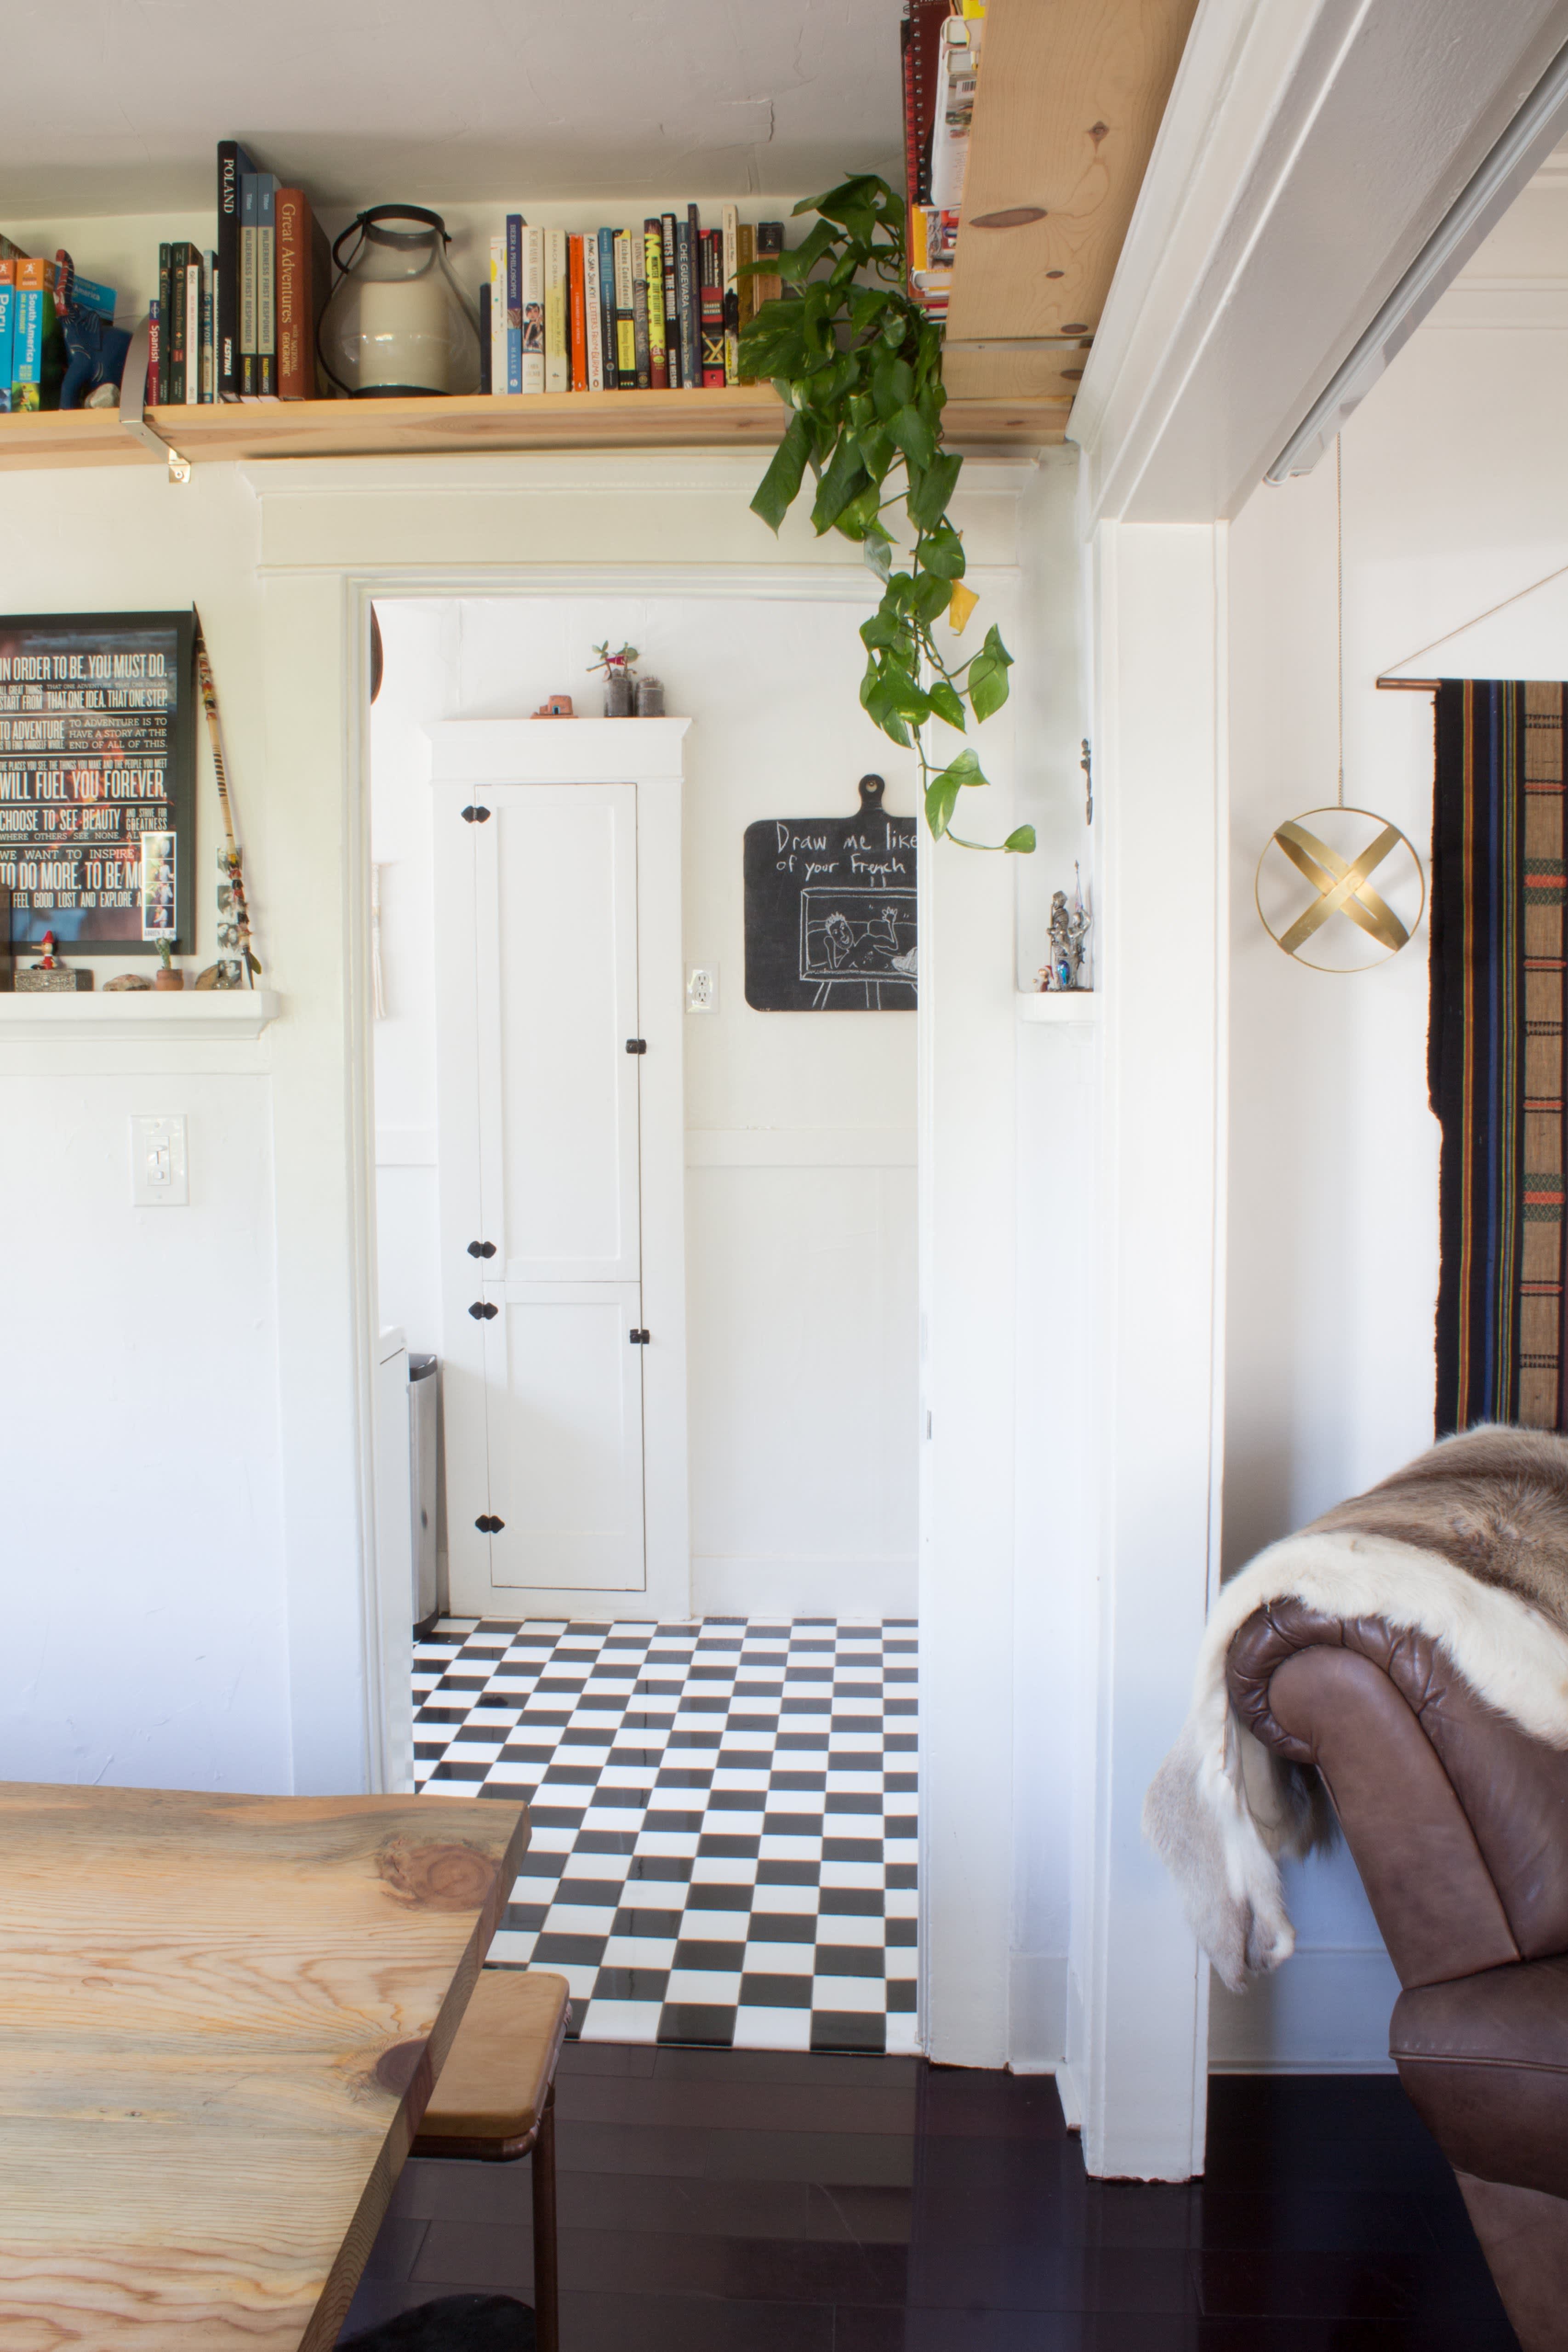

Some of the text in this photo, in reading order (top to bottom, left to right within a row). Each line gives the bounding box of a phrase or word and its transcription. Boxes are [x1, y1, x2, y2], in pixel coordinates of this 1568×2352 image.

[224, 159, 234, 214] POLAND
[587, 238, 595, 257] AUNG
[680, 242, 689, 262] CHE
[281, 204, 296, 324] Great Adventures
[663, 217, 676, 321] MONKEYS IN THE MIDDLE
[589, 286, 597, 298] KYI
[621, 267, 630, 308] Confidential
[680, 264, 690, 308] GUEVARA
[27, 293, 37, 362] South America
[149, 325, 160, 363] Spanish
[589, 302, 599, 377] LETTERS FROM BURMA
[281, 332, 291, 377] GEOGRAPHIC
[669, 349, 678, 388] NICK NELSON
[0, 653, 167, 681] IN ORDER TO BE, YOU MUST DO.
[8, 685, 43, 695] GREAT THINGS
[47, 689, 167, 709] THAT ONE IDEA. THAT ONE STEP.
[0, 695, 42, 710] START FROM
[0, 720, 65, 741] TO ADVENTURE
[69, 719, 82, 728] TO
[84, 718, 140, 727] ADVENTURE
[154, 718, 167, 726] TO
[5, 740, 11, 750] TO
[12, 740, 23, 750] FIND
[23, 739, 47, 750] YOURSELF
[69, 729, 167, 739] HAVE A STORY AT THE
[69, 741, 89, 749] END
[91, 741, 104, 749] OF
[107, 740, 125, 748] ALL
[144, 740, 168, 748] THIS.
[9, 761, 26, 771] PLACES
[27, 761, 37, 771] YOU
[49, 760, 58, 771] THE
[59, 760, 77, 771] THINGS
[78, 760, 87, 770] YOU
[88, 760, 102, 770] MAKE
[103, 759, 113, 770] AND
[114, 759, 124, 770] THE
[125, 759, 142, 769] PEOPLE
[143, 759, 153, 769] YOU
[154, 759, 167, 769] MEET
[0, 771, 31, 800] WILL
[36, 771, 68, 799] FUEL
[72, 771, 99, 799] YOU
[0, 808, 121, 831] CHOOSE TO SEE BEAUTY
[126, 808, 167, 817] AND STRIVE FOR
[125, 817, 167, 830] GREATNESS
[34, 832, 68, 840] OTHERS
[776, 821, 918, 853] Draw me like
[0, 849, 135, 861] WE WANT TO INSPIRE
[0, 861, 122, 890] TO DO MORE. TO BE
[776, 853, 906, 882] of your French
[13, 891, 132, 908] FEEL GOOD LOST AND EXPLORE
